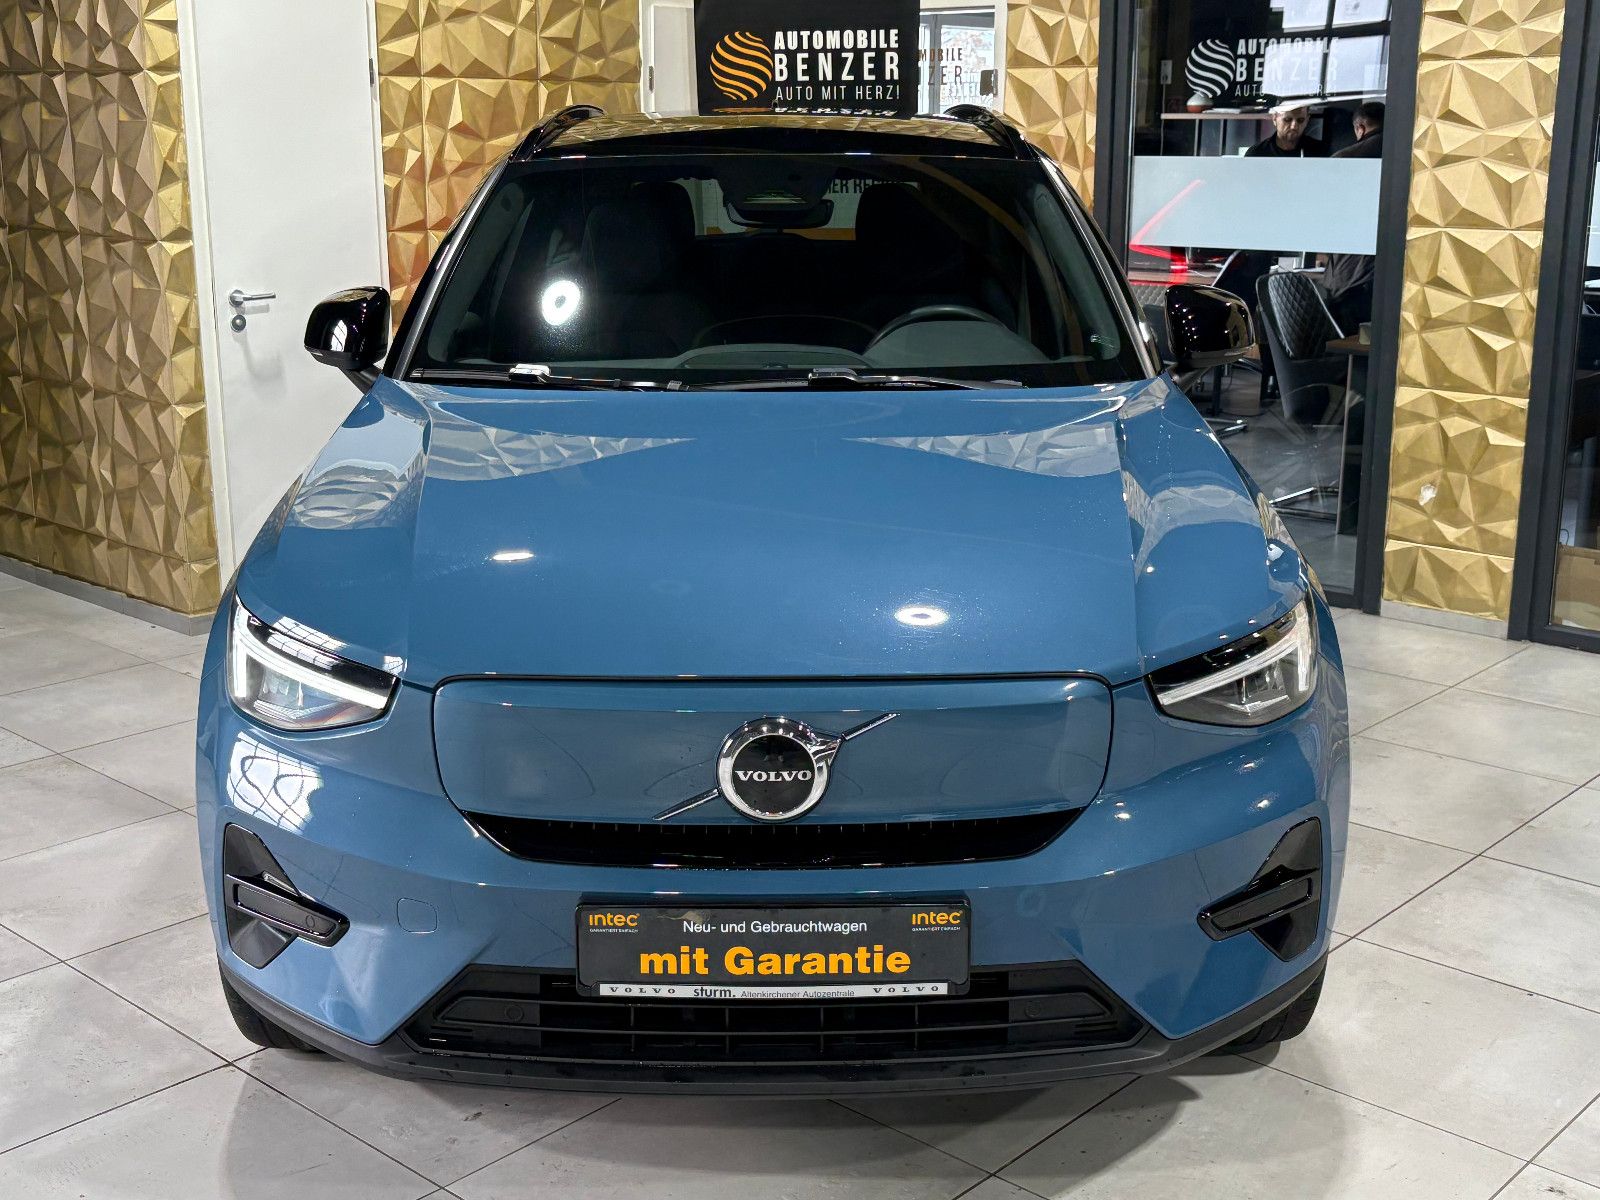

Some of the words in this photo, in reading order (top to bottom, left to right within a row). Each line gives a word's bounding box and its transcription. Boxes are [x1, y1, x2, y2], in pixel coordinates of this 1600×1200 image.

[774, 29, 899, 50] AUTOMOBILE
[775, 52, 899, 82] BENZER
[1235, 57, 1337, 82] BENZER
[776, 86, 813, 101] AUTO
[821, 85, 846, 100] MIT
[856, 85, 900, 100] HERZ!
[735, 770, 812, 782] VOLVO
[589, 912, 639, 927] intec
[911, 911, 961, 926] intec
[683, 921, 717, 933] Neu-
[720, 921, 746, 933] und
[750, 920, 868, 935] Gebrauchtwagen
[640, 945, 709, 975] mit
[724, 944, 911, 976] Garantie
[609, 986, 677, 995] VOLVO
[693, 986, 736, 999] sturm.
[740, 989, 801, 999] Altenkirchener
[802, 989, 855, 999] Autozentrale
[873, 985, 939, 994] VOLVO
